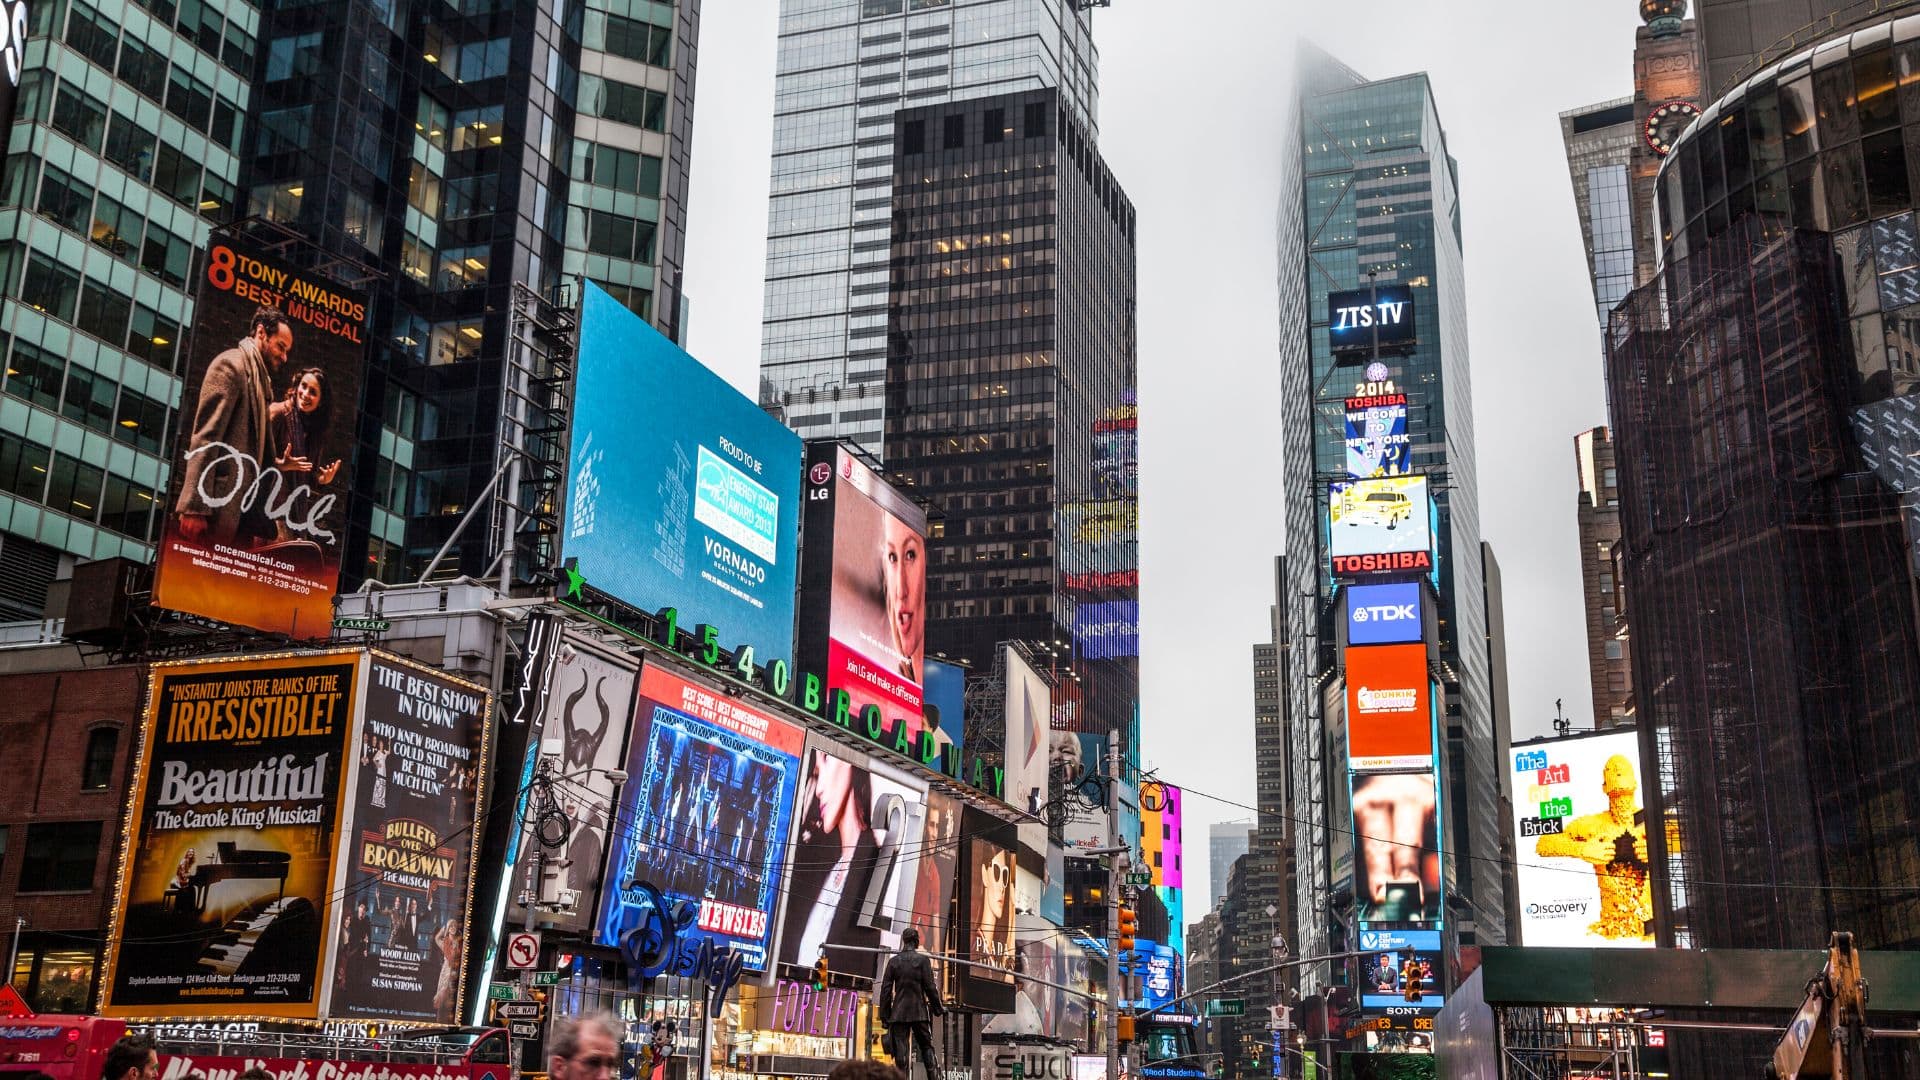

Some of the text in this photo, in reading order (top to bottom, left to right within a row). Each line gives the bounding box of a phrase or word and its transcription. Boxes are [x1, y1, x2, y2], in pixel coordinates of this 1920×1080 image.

[208, 245, 365, 321] 8 TONY AWARDS
[235, 281, 361, 344] BEST MUSICAL
[1337, 302, 1403, 329] 7TS.TV
[1355, 381, 1395, 397] 2014
[1346, 394, 1406, 409] TOSHIBA
[1346, 408, 1406, 422] WELCOME
[1369, 423, 1385, 433] TO
[1346, 434, 1409, 448] NEW YORK
[719, 436, 763, 476] PROUD TO BE
[1364, 446, 1392, 459] CITY
[729, 476, 757, 503] ENERGY
[757, 494, 775, 518] STAR
[810, 488, 828, 500] LG
[728, 496, 755, 524] AWARD
[755, 513, 773, 536] 2013
[214, 543, 295, 571] oncemusical.com
[704, 535, 765, 583] VORNADO
[1333, 552, 1430, 573] TOSHIBA
[192, 557, 248, 578] telecharge.com
[258, 574, 310, 595] 212-239-6200
[714, 560, 755, 588] REALTY TRUST
[1368, 604, 1416, 621] TDK
[338, 619, 387, 630] LAMAR
[223, 680, 251, 699] JOINS
[252, 679, 270, 696] THE
[271, 676, 304, 694] RANKS
[306, 676, 319, 693] OF
[319, 674, 339, 692] THE
[846, 657, 920, 707] Join LG and make a difference
[398, 694, 413, 717] IN
[406, 676, 440, 705] BEST
[441, 688, 480, 716] SHOW
[663, 607, 1004, 798] 1540 BROADWAY
[683, 700, 699, 714] 2012
[701, 707, 717, 720] TONY
[397, 727, 423, 745] KNEW
[425, 735, 471, 761] BROADWAY
[393, 742, 449, 770] COULD STILL
[1518, 755, 1545, 770] The
[157, 752, 329, 806] Beautiful
[402, 759, 437, 780] BE THIS
[1543, 768, 1565, 784] Art
[392, 771, 420, 790] MUCH
[155, 804, 323, 830] The Carole King Musical
[1545, 802, 1568, 816] the
[386, 821, 437, 848] BULLETS
[1524, 820, 1560, 836] Brick
[401, 838, 422, 851] OVER
[363, 843, 454, 880] BROADWAY
[384, 871, 431, 889] THE MUSICAL
[698, 900, 768, 938] NEWSIES
[1530, 903, 1587, 915] Discovery
[380, 948, 403, 959] WOODY
[403, 951, 421, 961] ALLEN
[976, 936, 1009, 957] PRADA
[371, 977, 422, 992] SUSAN STROMAN
[543, 974, 551, 984] 46
[491, 985, 507, 998] TIMES
[507, 1006, 535, 1014] ONE WAY
[772, 980, 858, 1038] FOREVER
[1386, 1007, 1421, 1015] SONY
[324, 1023, 368, 1041] GIFTS
[515, 1025, 524, 1033] ONE
